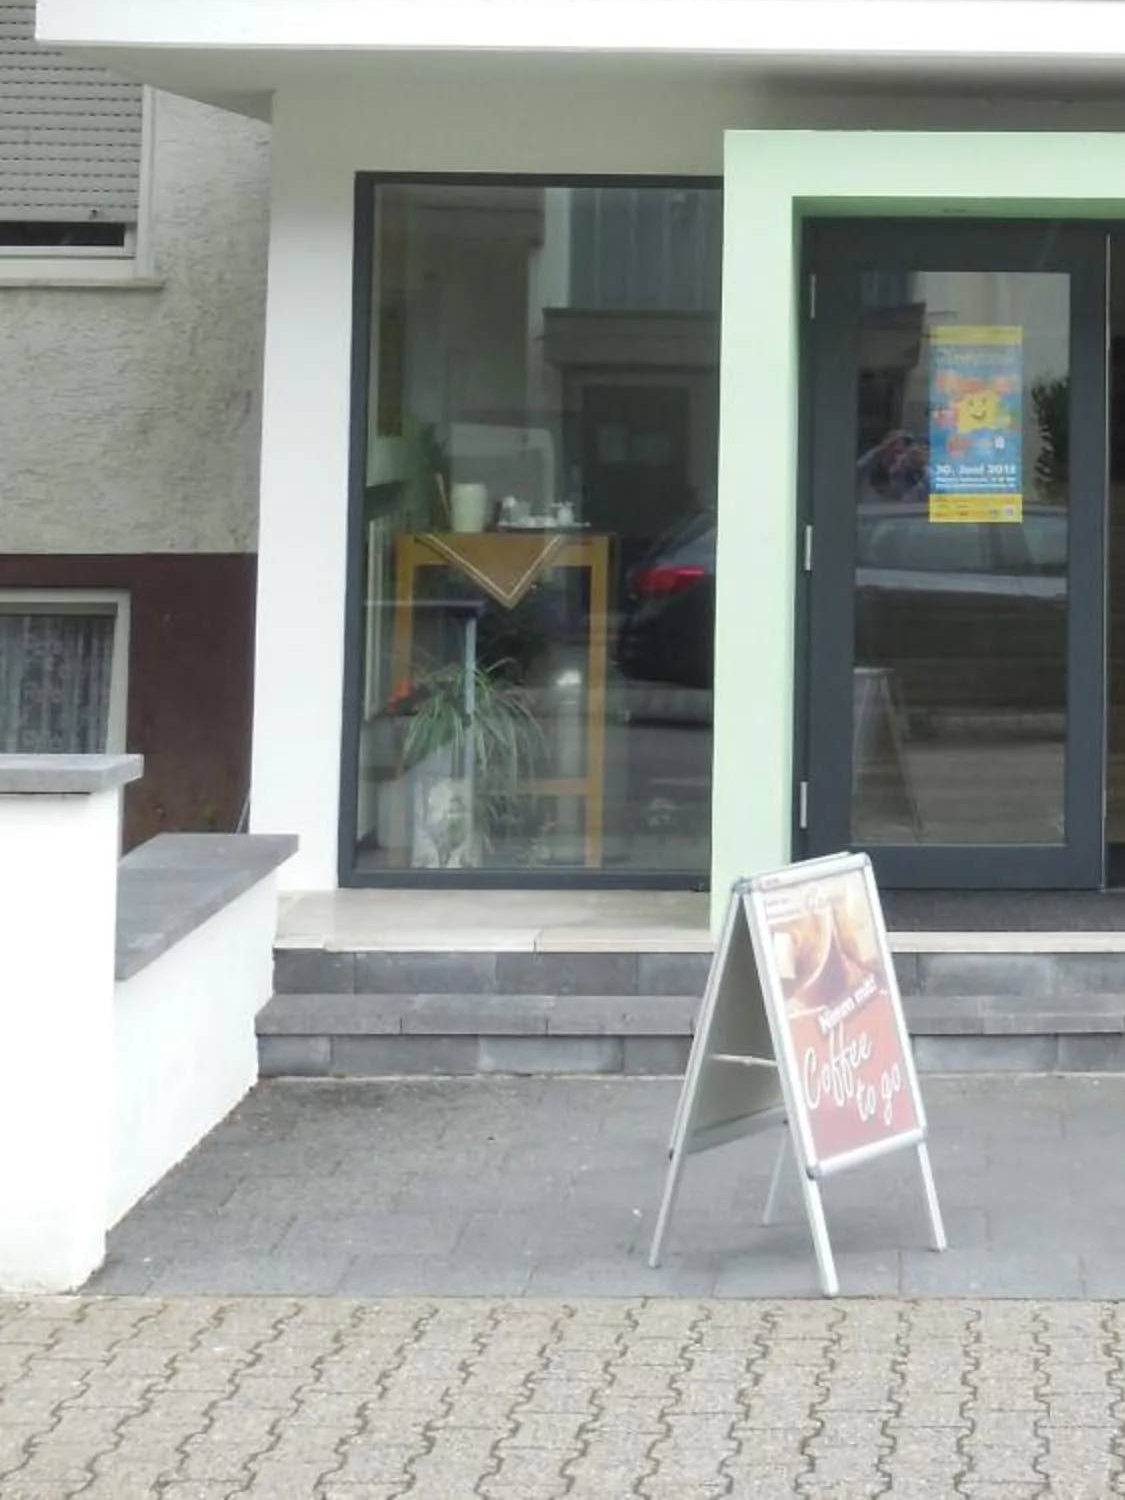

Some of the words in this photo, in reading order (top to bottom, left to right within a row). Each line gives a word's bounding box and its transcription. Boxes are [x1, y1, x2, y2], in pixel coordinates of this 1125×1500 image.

[804, 1022, 872, 1108] Coffee
[856, 1077, 877, 1122] to
[881, 1062, 903, 1126] go
